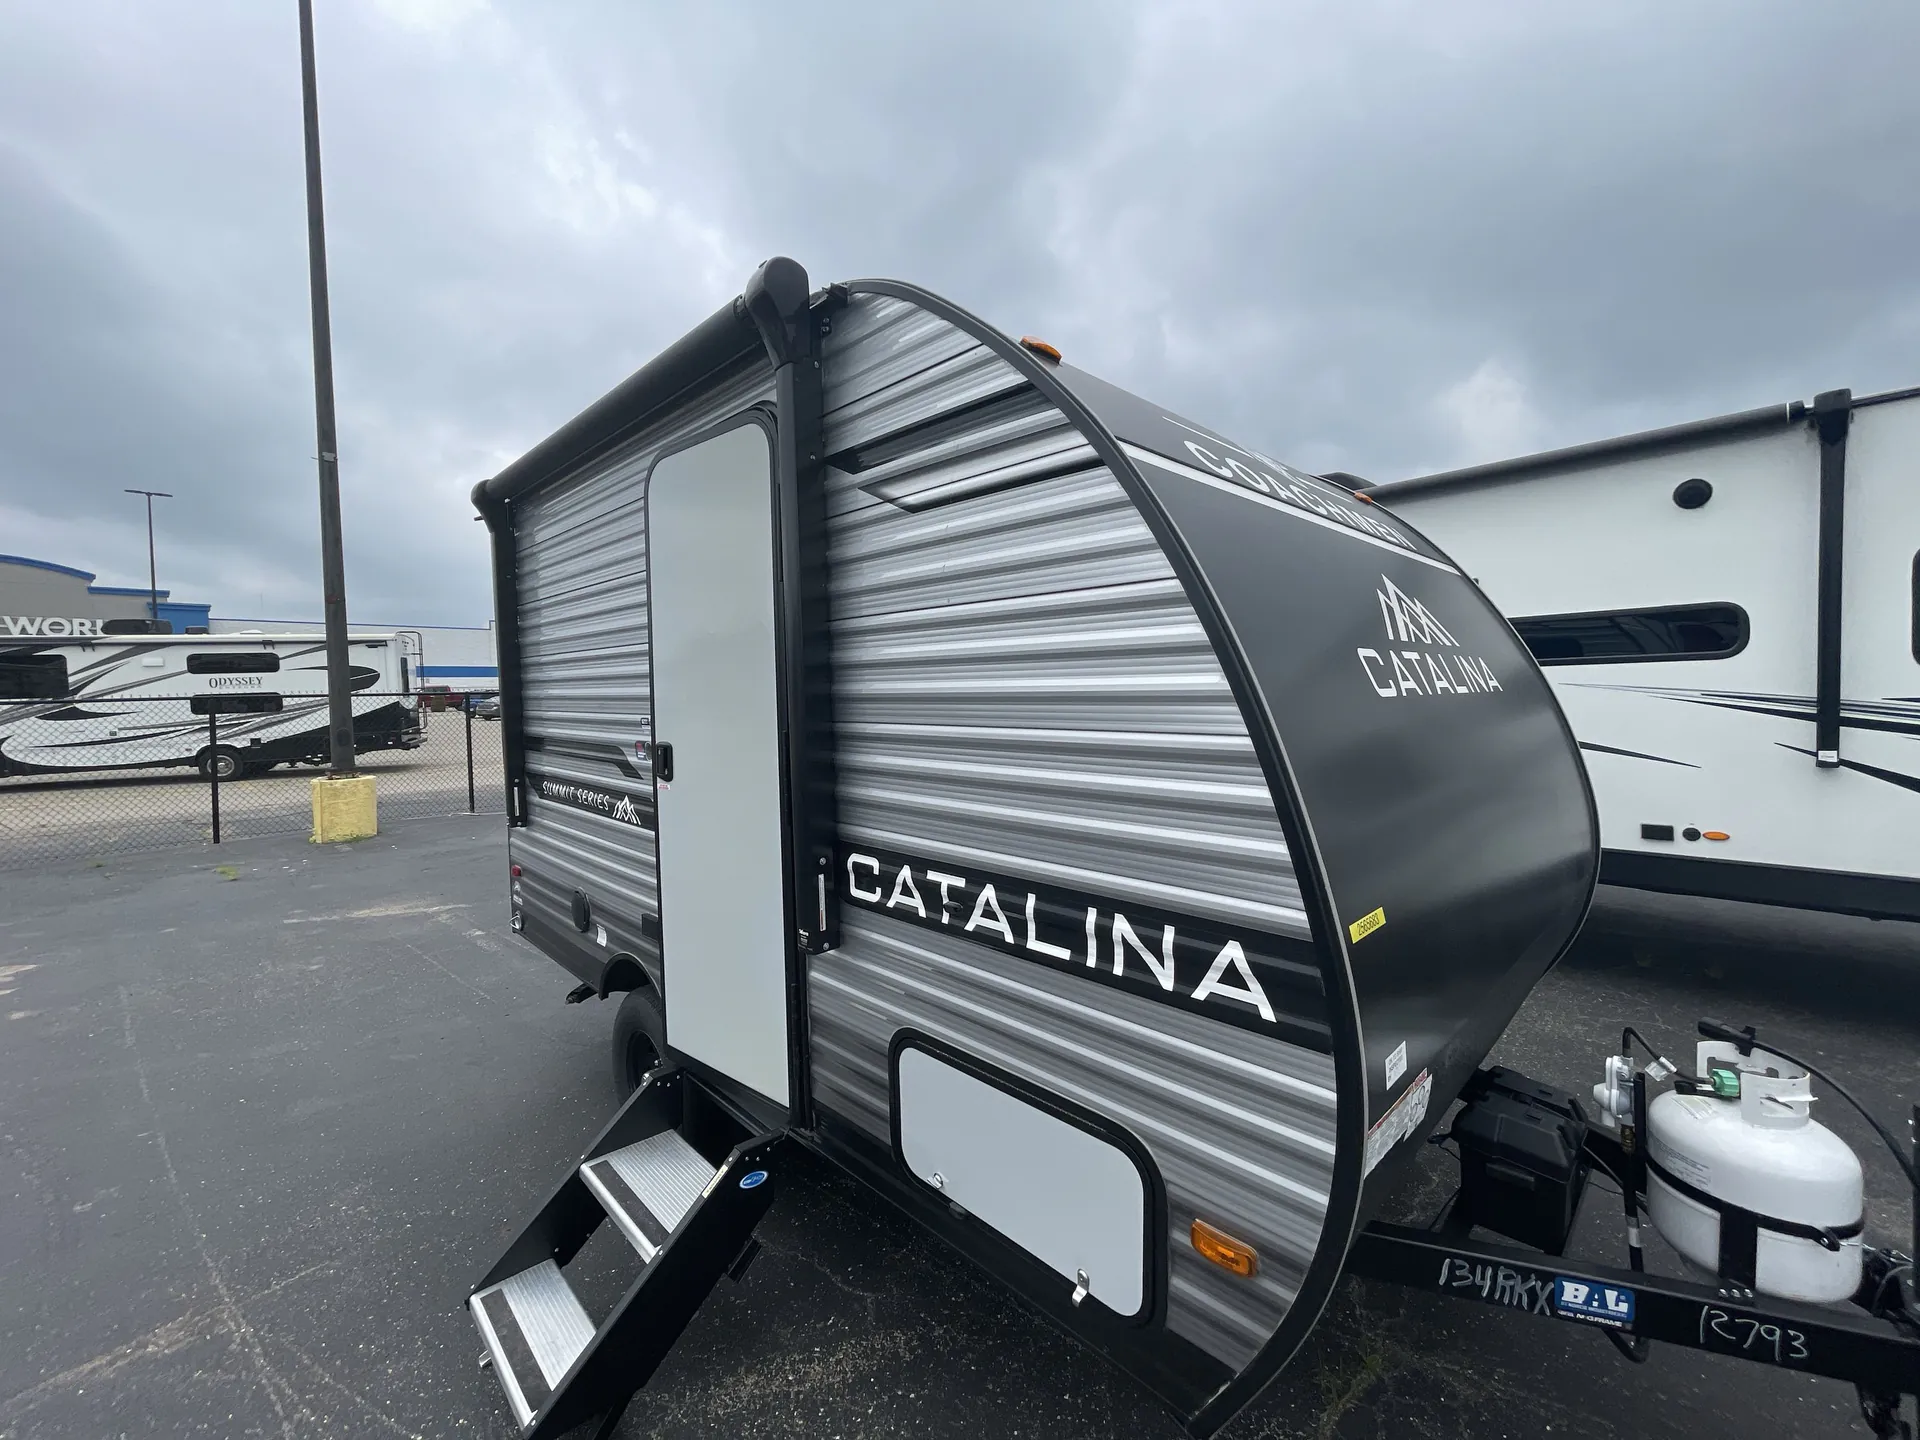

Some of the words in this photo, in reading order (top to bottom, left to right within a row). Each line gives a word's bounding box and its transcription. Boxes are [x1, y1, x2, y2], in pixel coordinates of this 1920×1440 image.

[1183, 440, 1417, 550] COACHMEN
[209, 676, 263, 688] ODYSSEY
[1357, 648, 1503, 697] CATALINA
[543, 781, 575, 800] SUMMIT
[577, 788, 610, 811] SERIES
[847, 852, 1277, 1023] CATALINA
[1438, 1258, 1555, 1317] 134RKX
